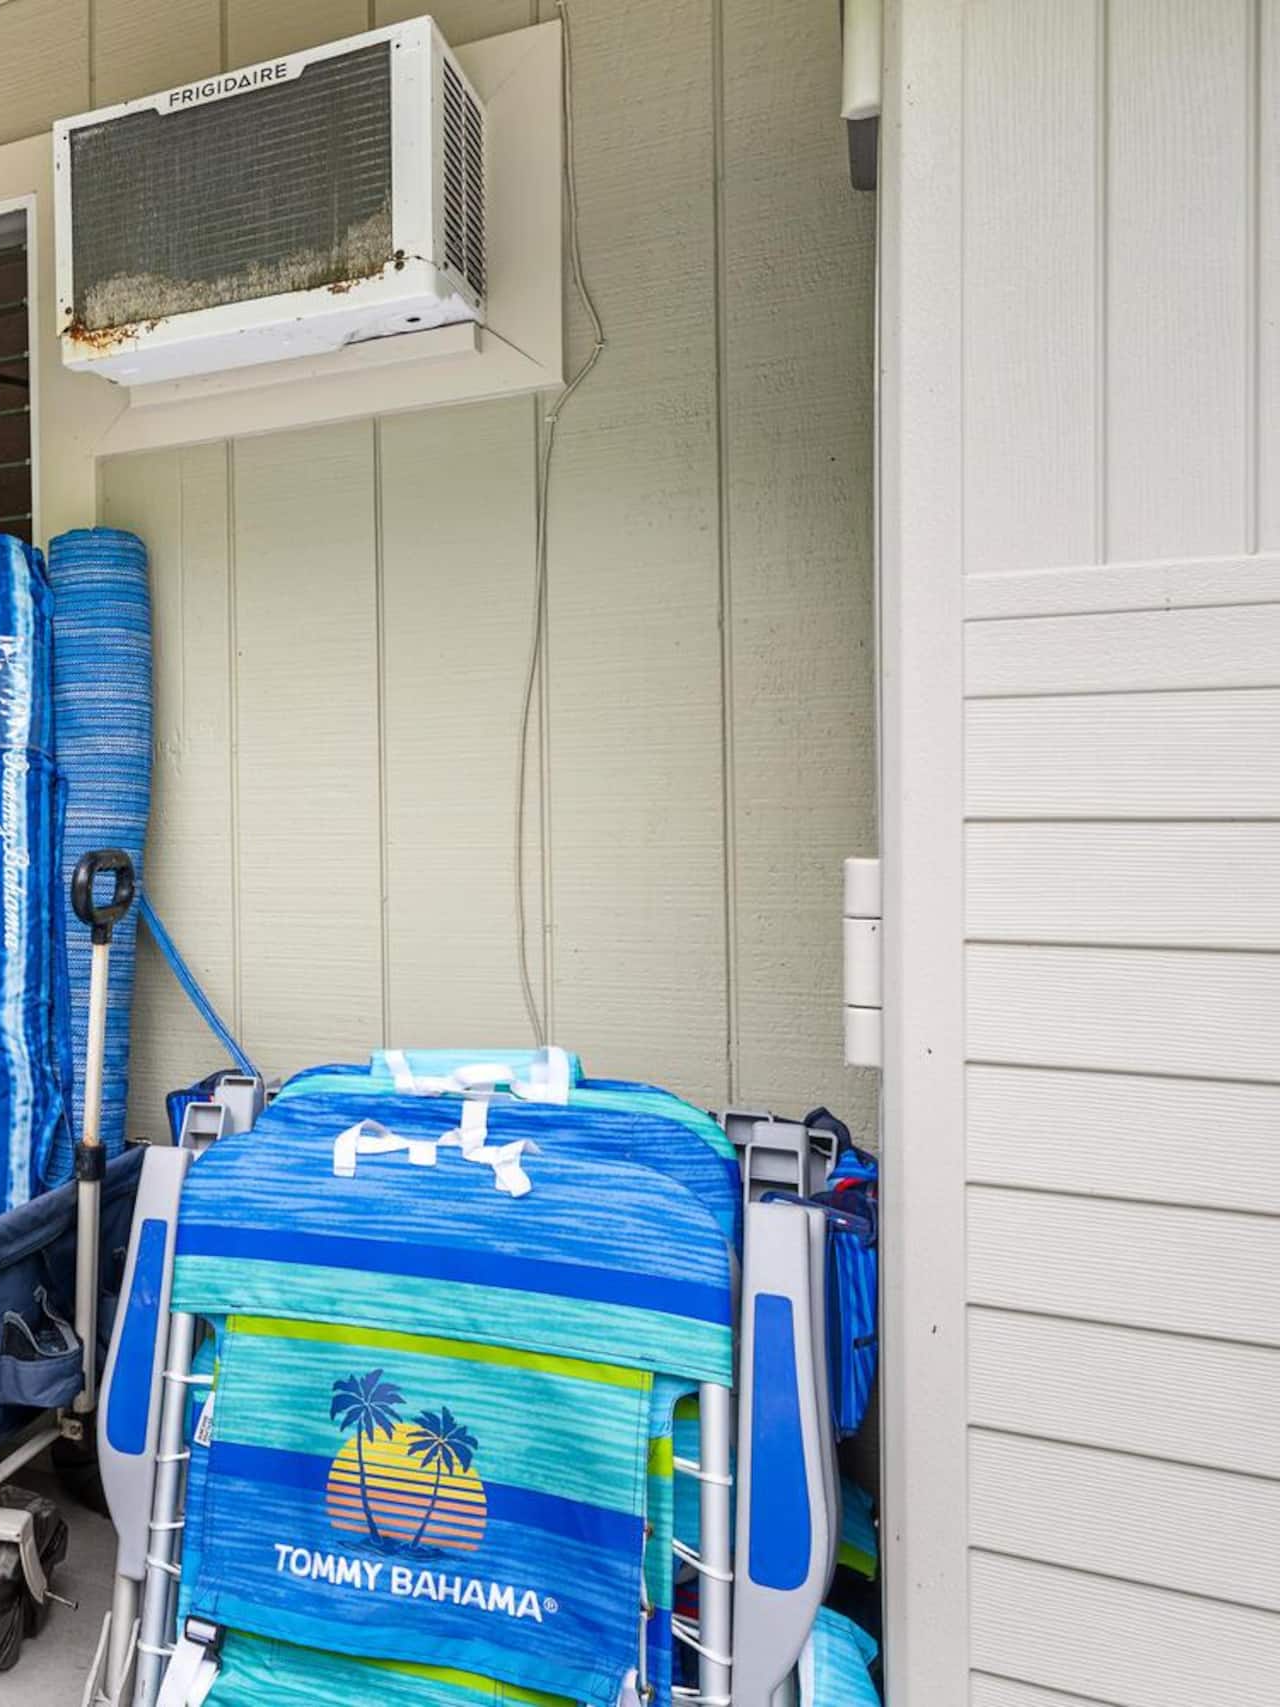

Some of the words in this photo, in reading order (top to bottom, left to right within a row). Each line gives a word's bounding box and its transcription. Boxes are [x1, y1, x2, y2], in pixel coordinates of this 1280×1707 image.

[169, 63, 287, 107] FRIGIDAIRE
[3, 840, 30, 953] Bahama
[274, 1544, 383, 1591] TOMMY
